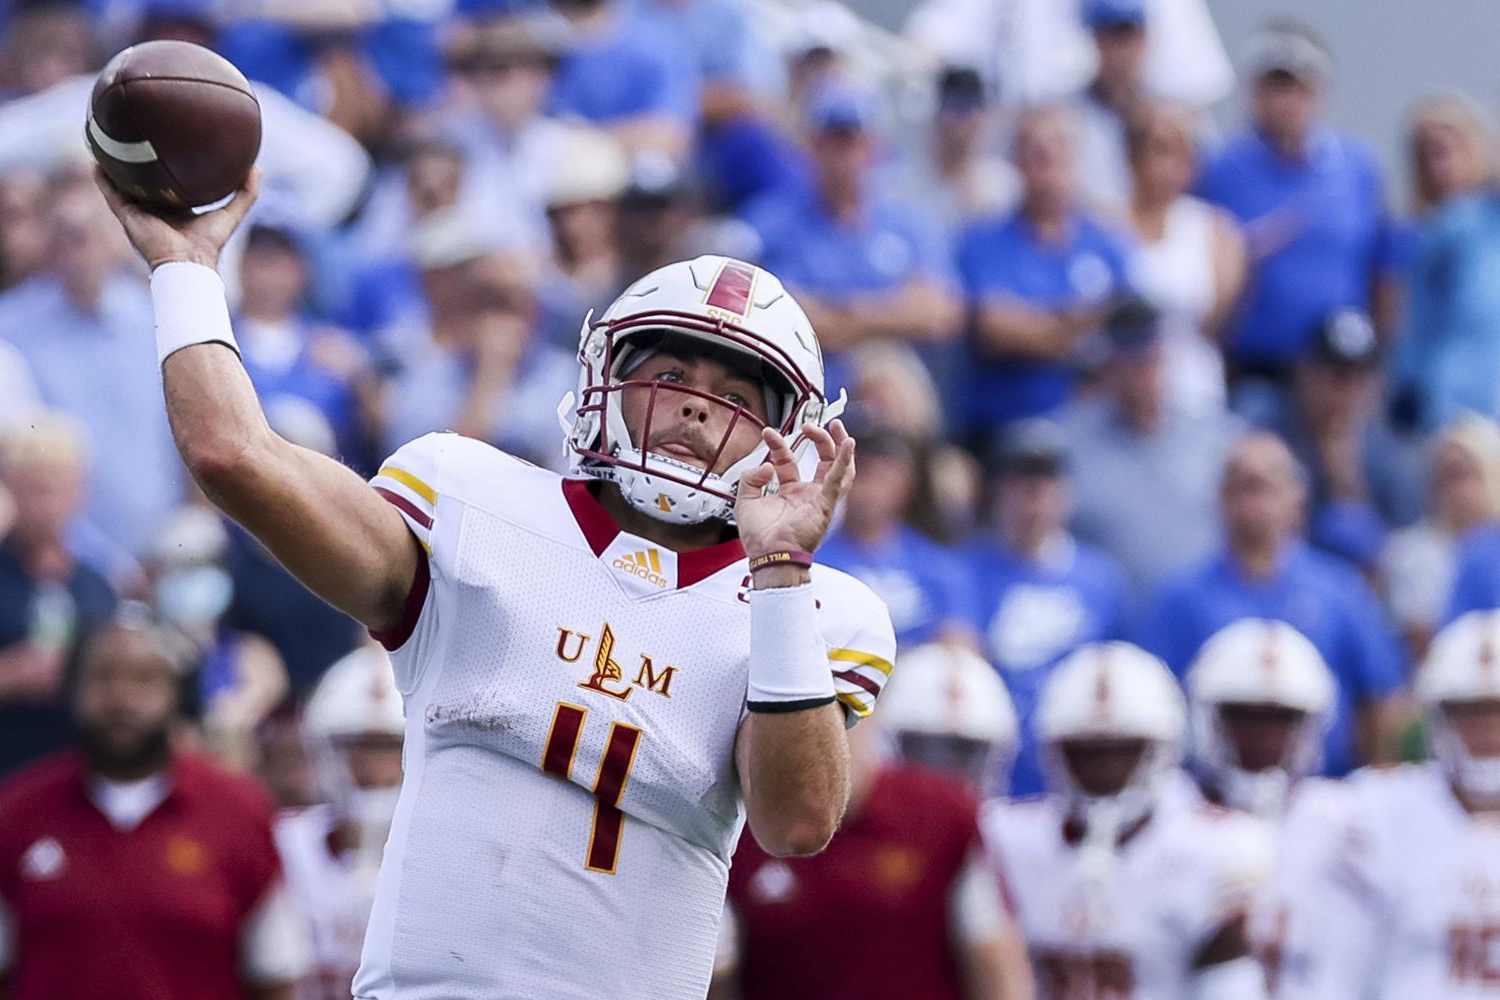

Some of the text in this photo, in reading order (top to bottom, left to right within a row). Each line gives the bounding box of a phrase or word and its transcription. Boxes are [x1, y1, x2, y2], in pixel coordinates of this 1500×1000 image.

[612, 557, 668, 589] adidas
[556, 621, 679, 702] ULM
[541, 701, 643, 875] 4
